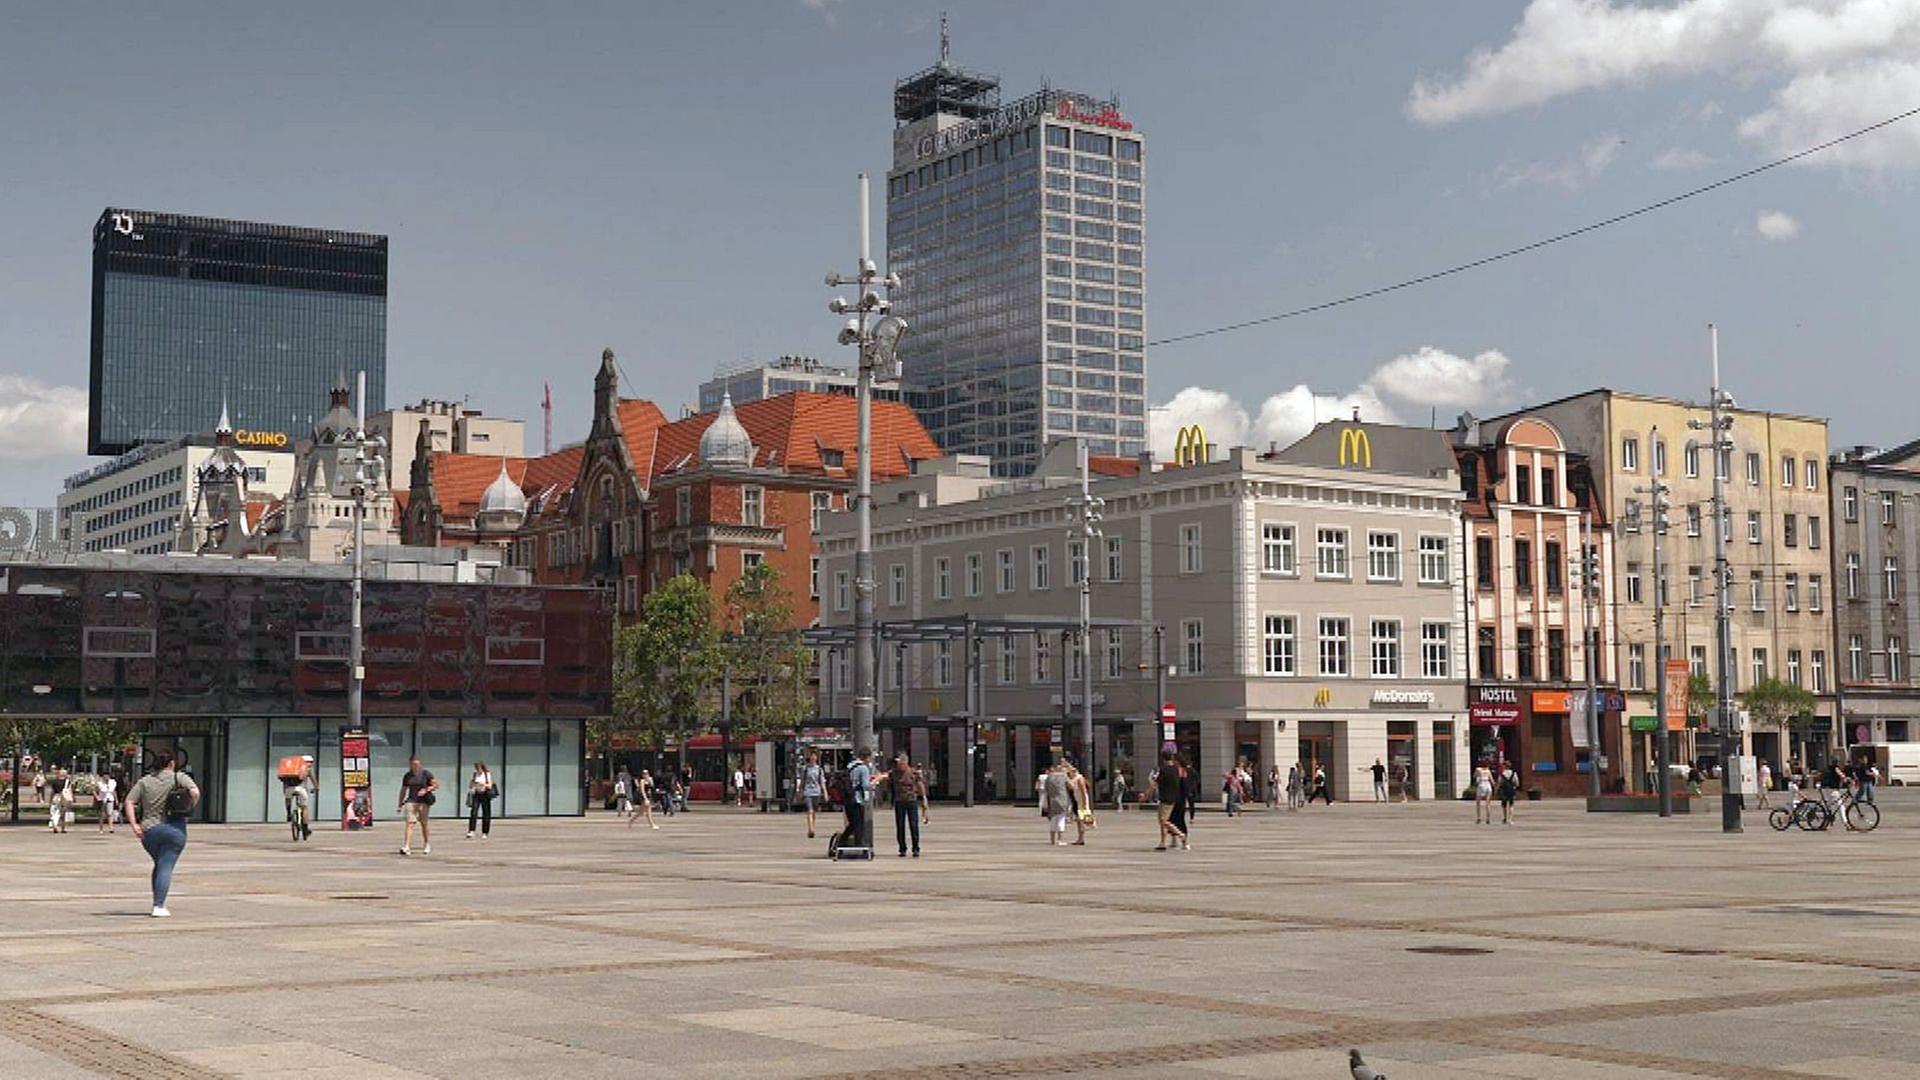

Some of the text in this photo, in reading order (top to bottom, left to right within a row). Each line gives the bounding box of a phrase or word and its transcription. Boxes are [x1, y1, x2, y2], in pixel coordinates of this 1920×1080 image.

[235, 429, 287, 446] CASINO
[1373, 689, 1435, 703] McDonald's
[1480, 687, 1518, 702] HOSTEL
